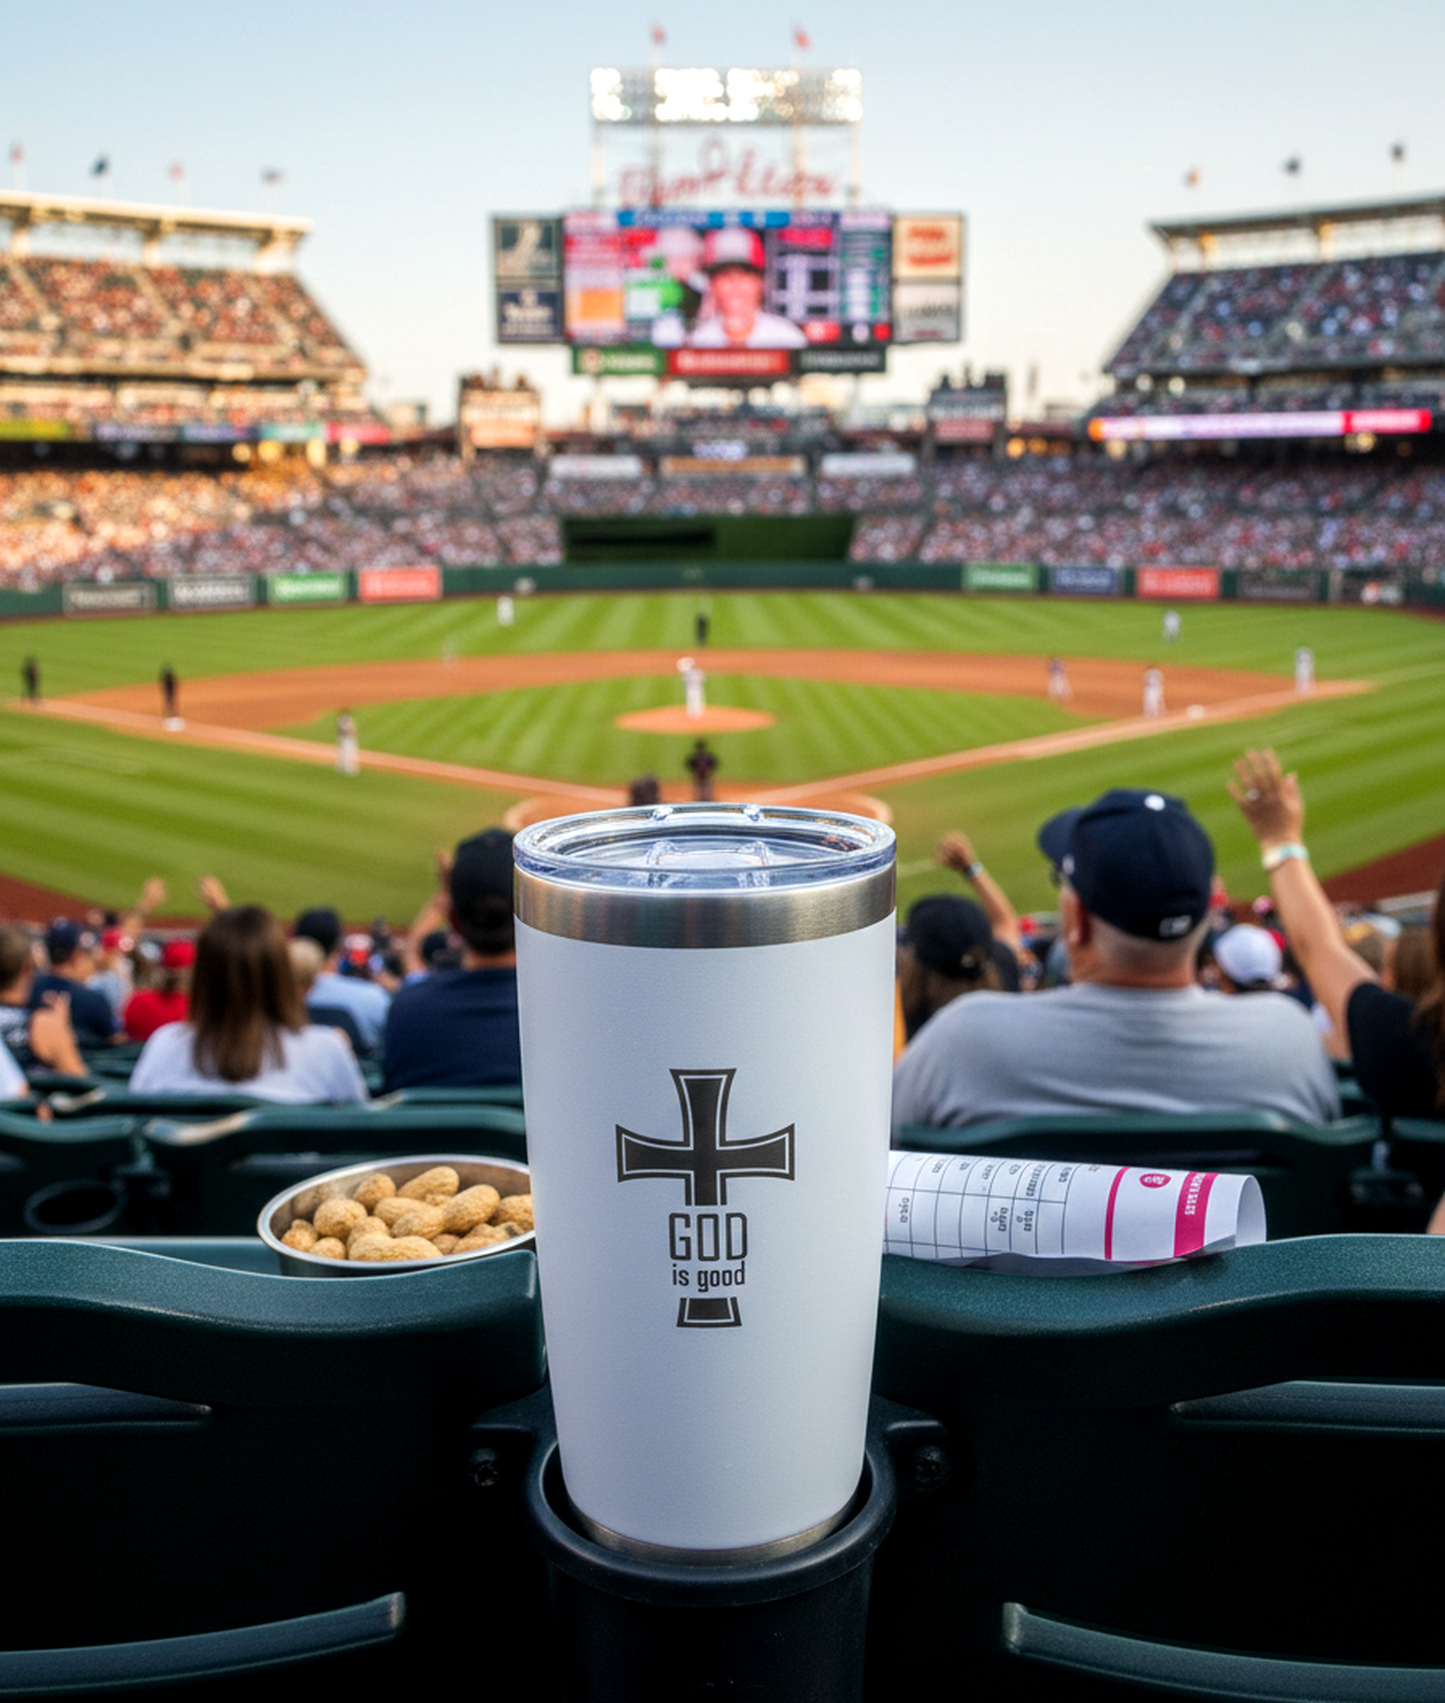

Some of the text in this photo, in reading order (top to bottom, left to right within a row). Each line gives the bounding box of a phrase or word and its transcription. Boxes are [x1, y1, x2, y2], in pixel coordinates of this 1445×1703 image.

[669, 1212, 748, 1262] GOD
[672, 1260, 746, 1293] is good
